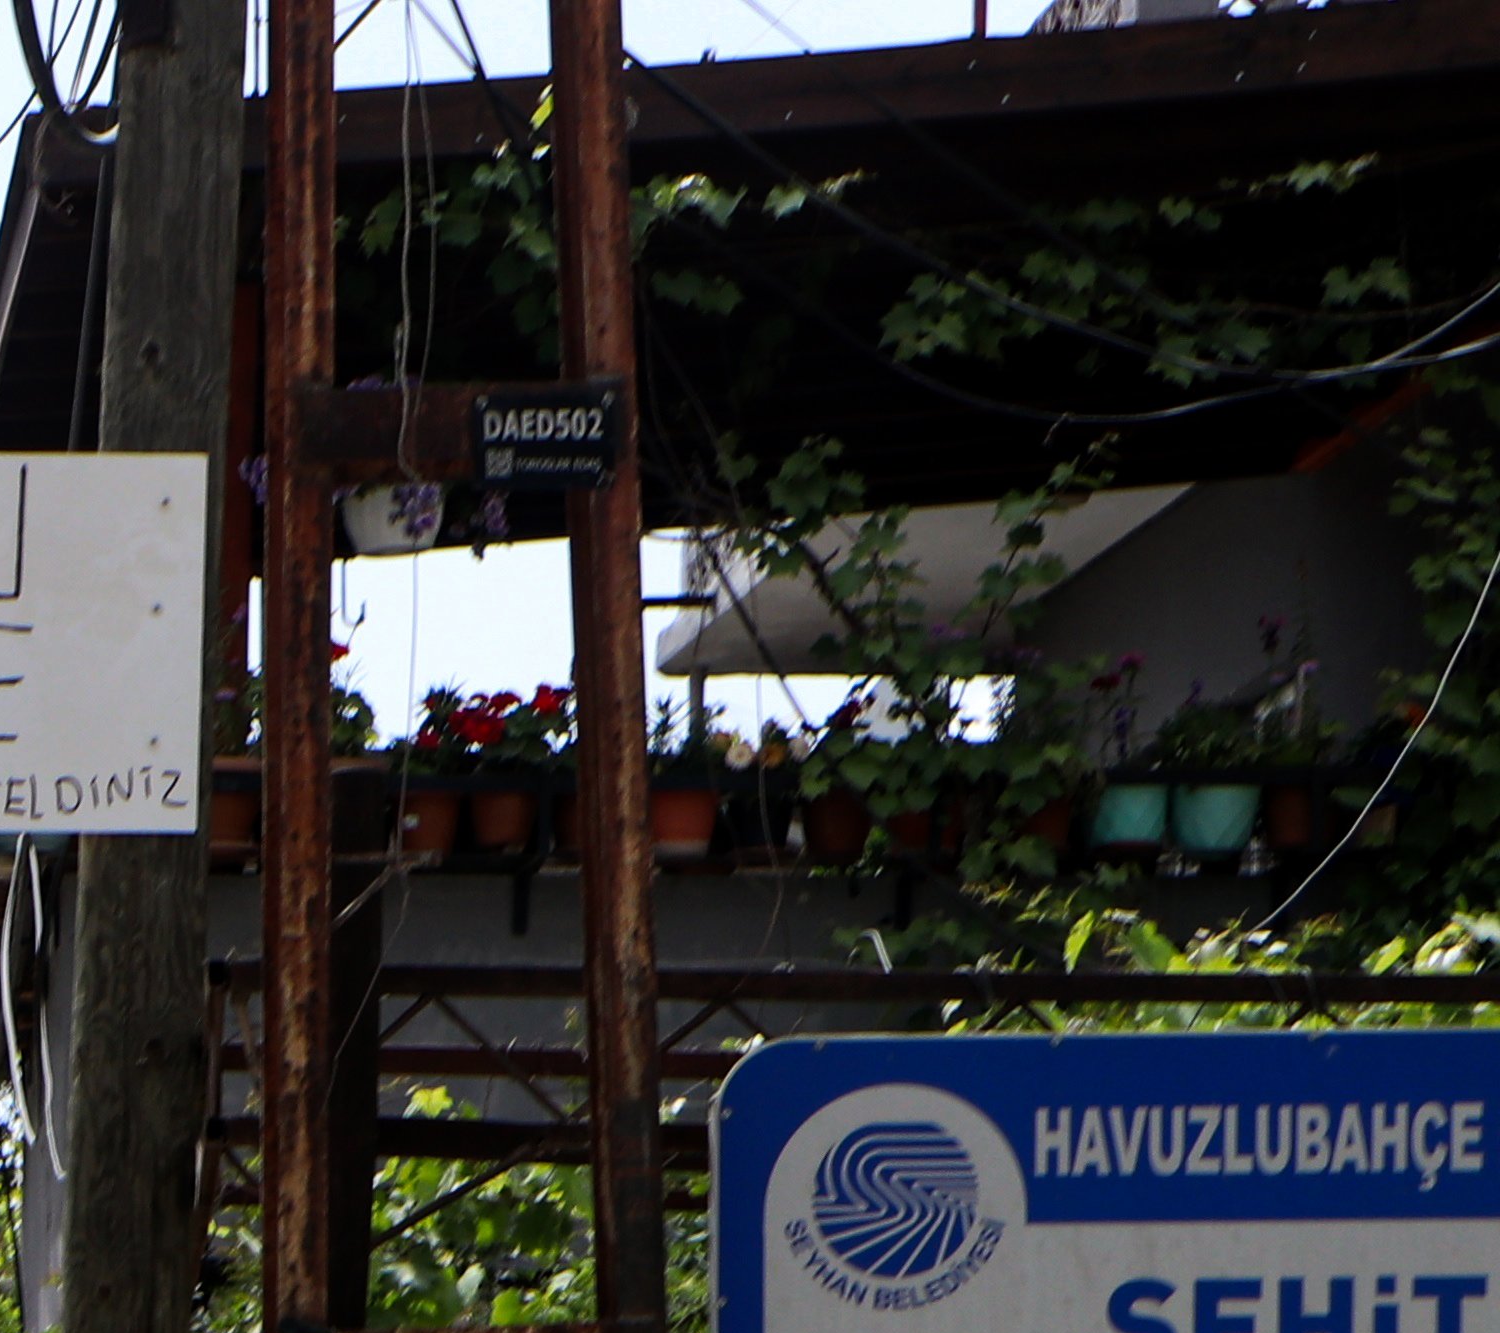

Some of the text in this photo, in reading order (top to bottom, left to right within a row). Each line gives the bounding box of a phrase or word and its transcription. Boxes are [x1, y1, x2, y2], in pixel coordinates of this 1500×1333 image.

[483, 408, 604, 441] DAED502
[1032, 1101, 1485, 1192] HAVUZLUBAHÇE
[784, 1217, 868, 1307] SEYHAN
